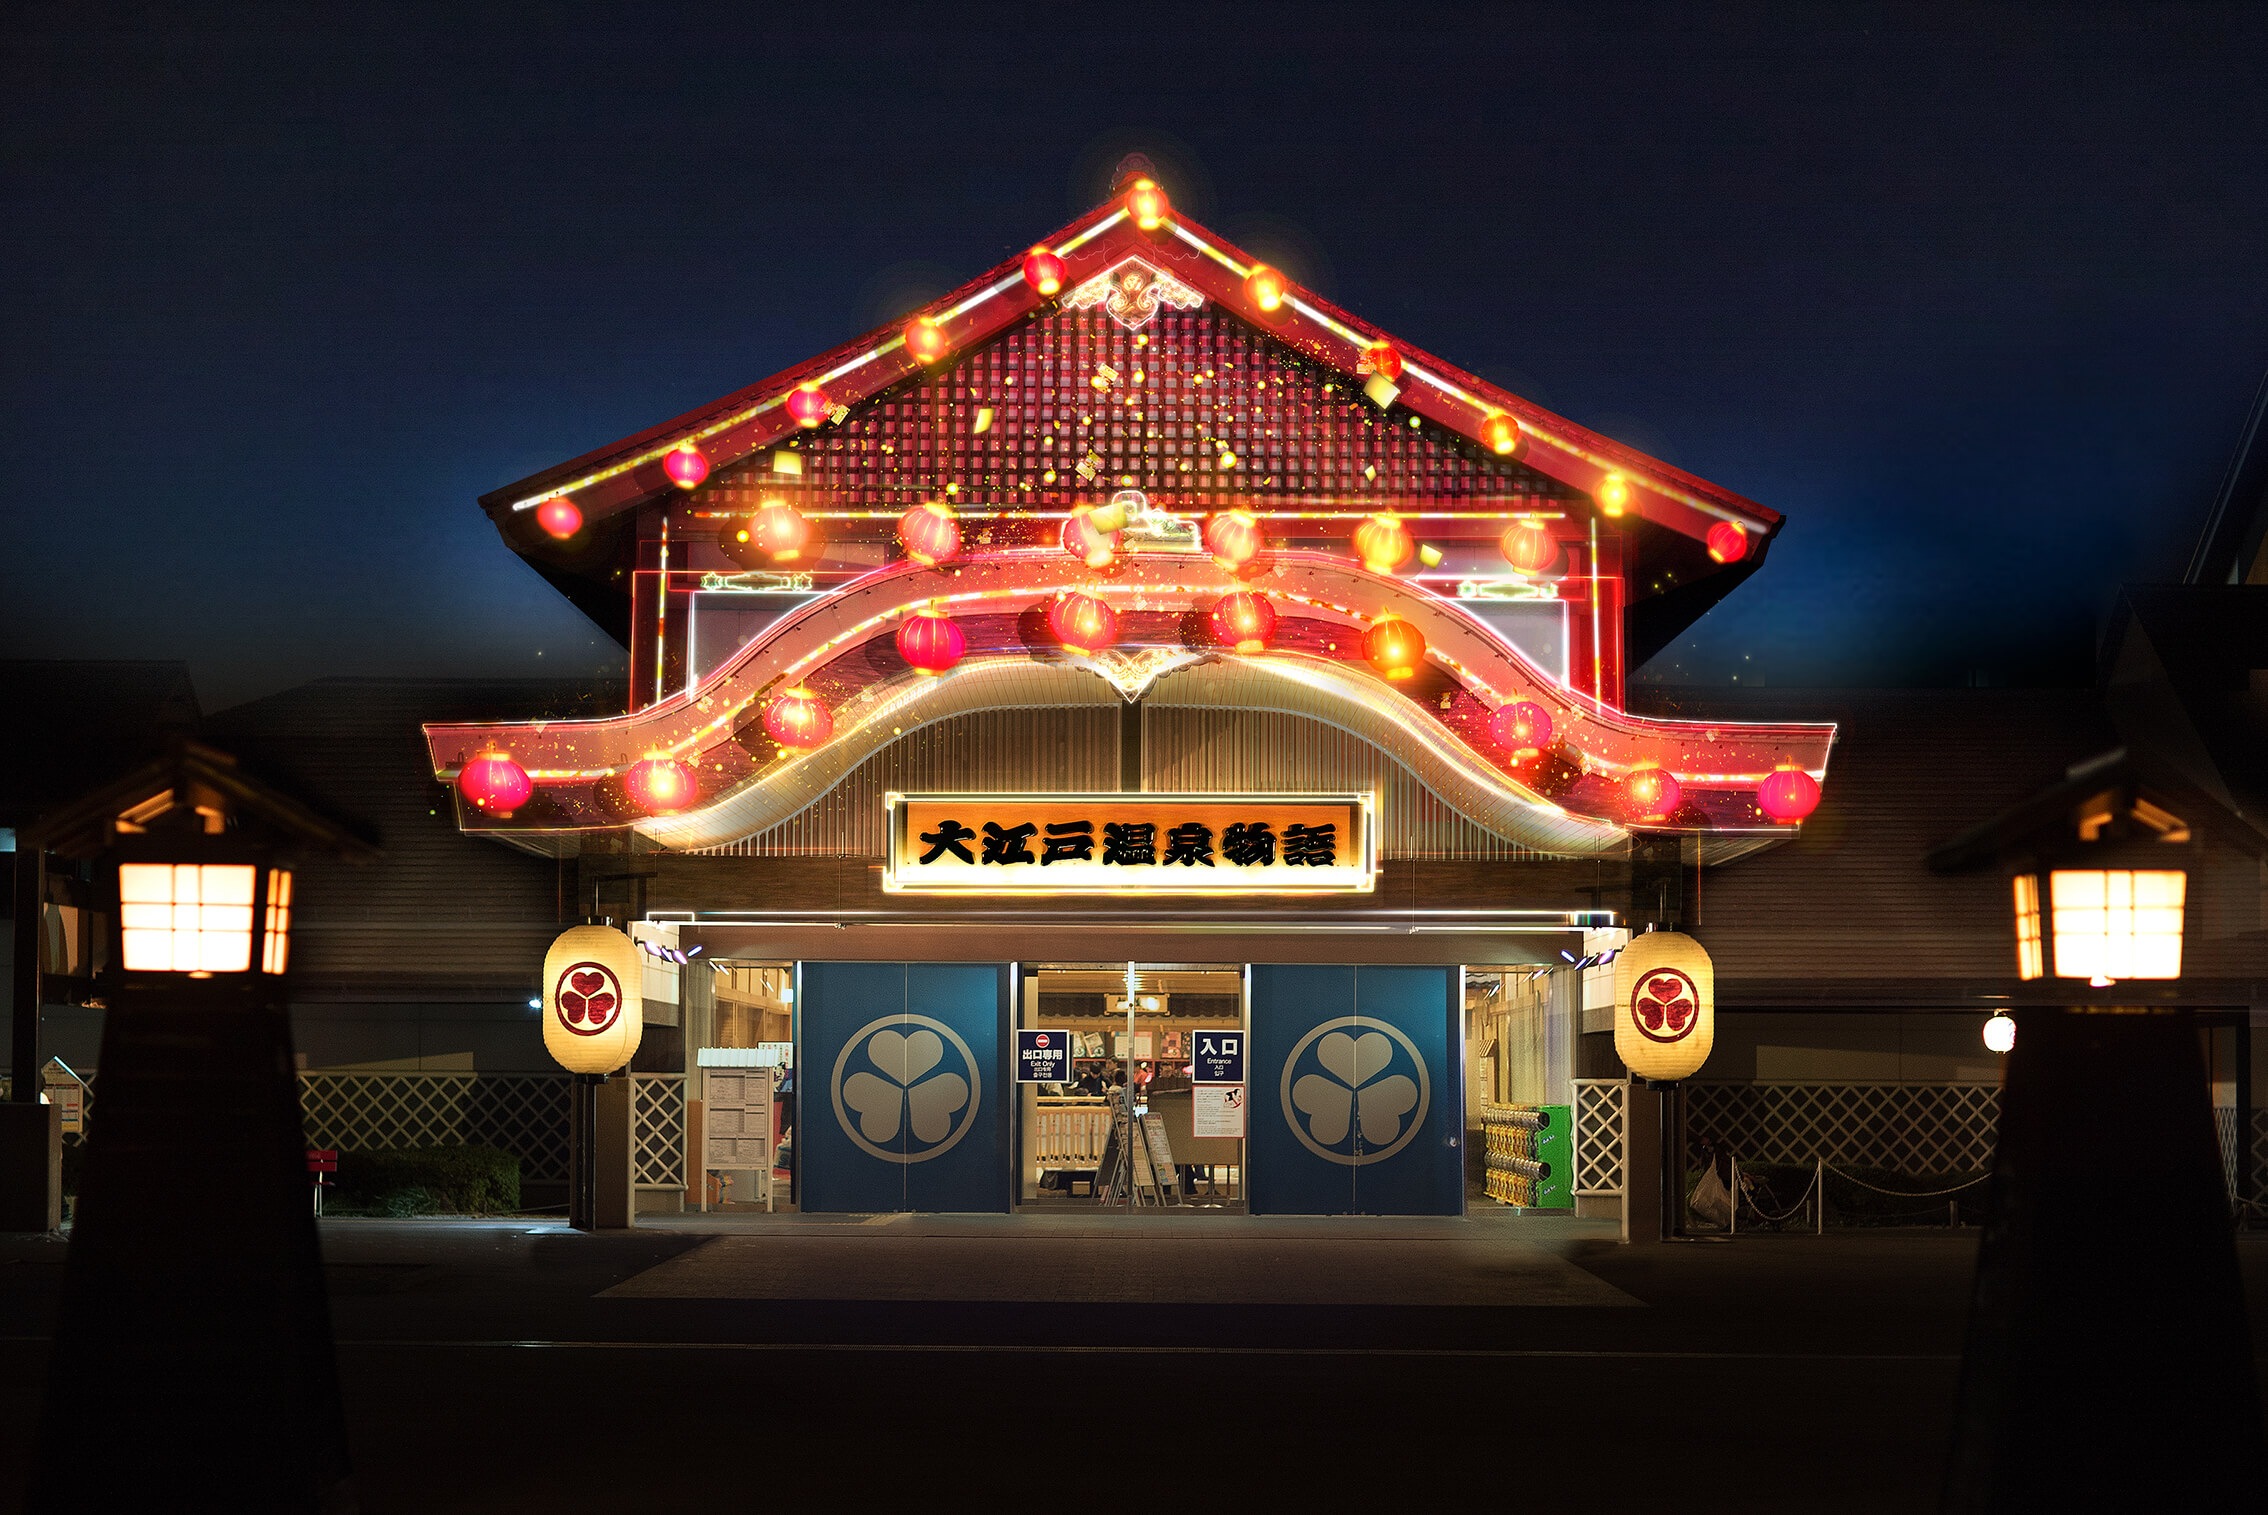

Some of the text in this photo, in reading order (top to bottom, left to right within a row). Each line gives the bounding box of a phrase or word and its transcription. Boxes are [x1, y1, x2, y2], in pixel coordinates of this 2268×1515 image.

[918, 819, 1338, 868] 大江戸温泉物語
[1200, 1038, 1238, 1056] 入口
[1022, 1049, 1063, 1060] 出口専用
[1042, 1060, 1055, 1068] Only
